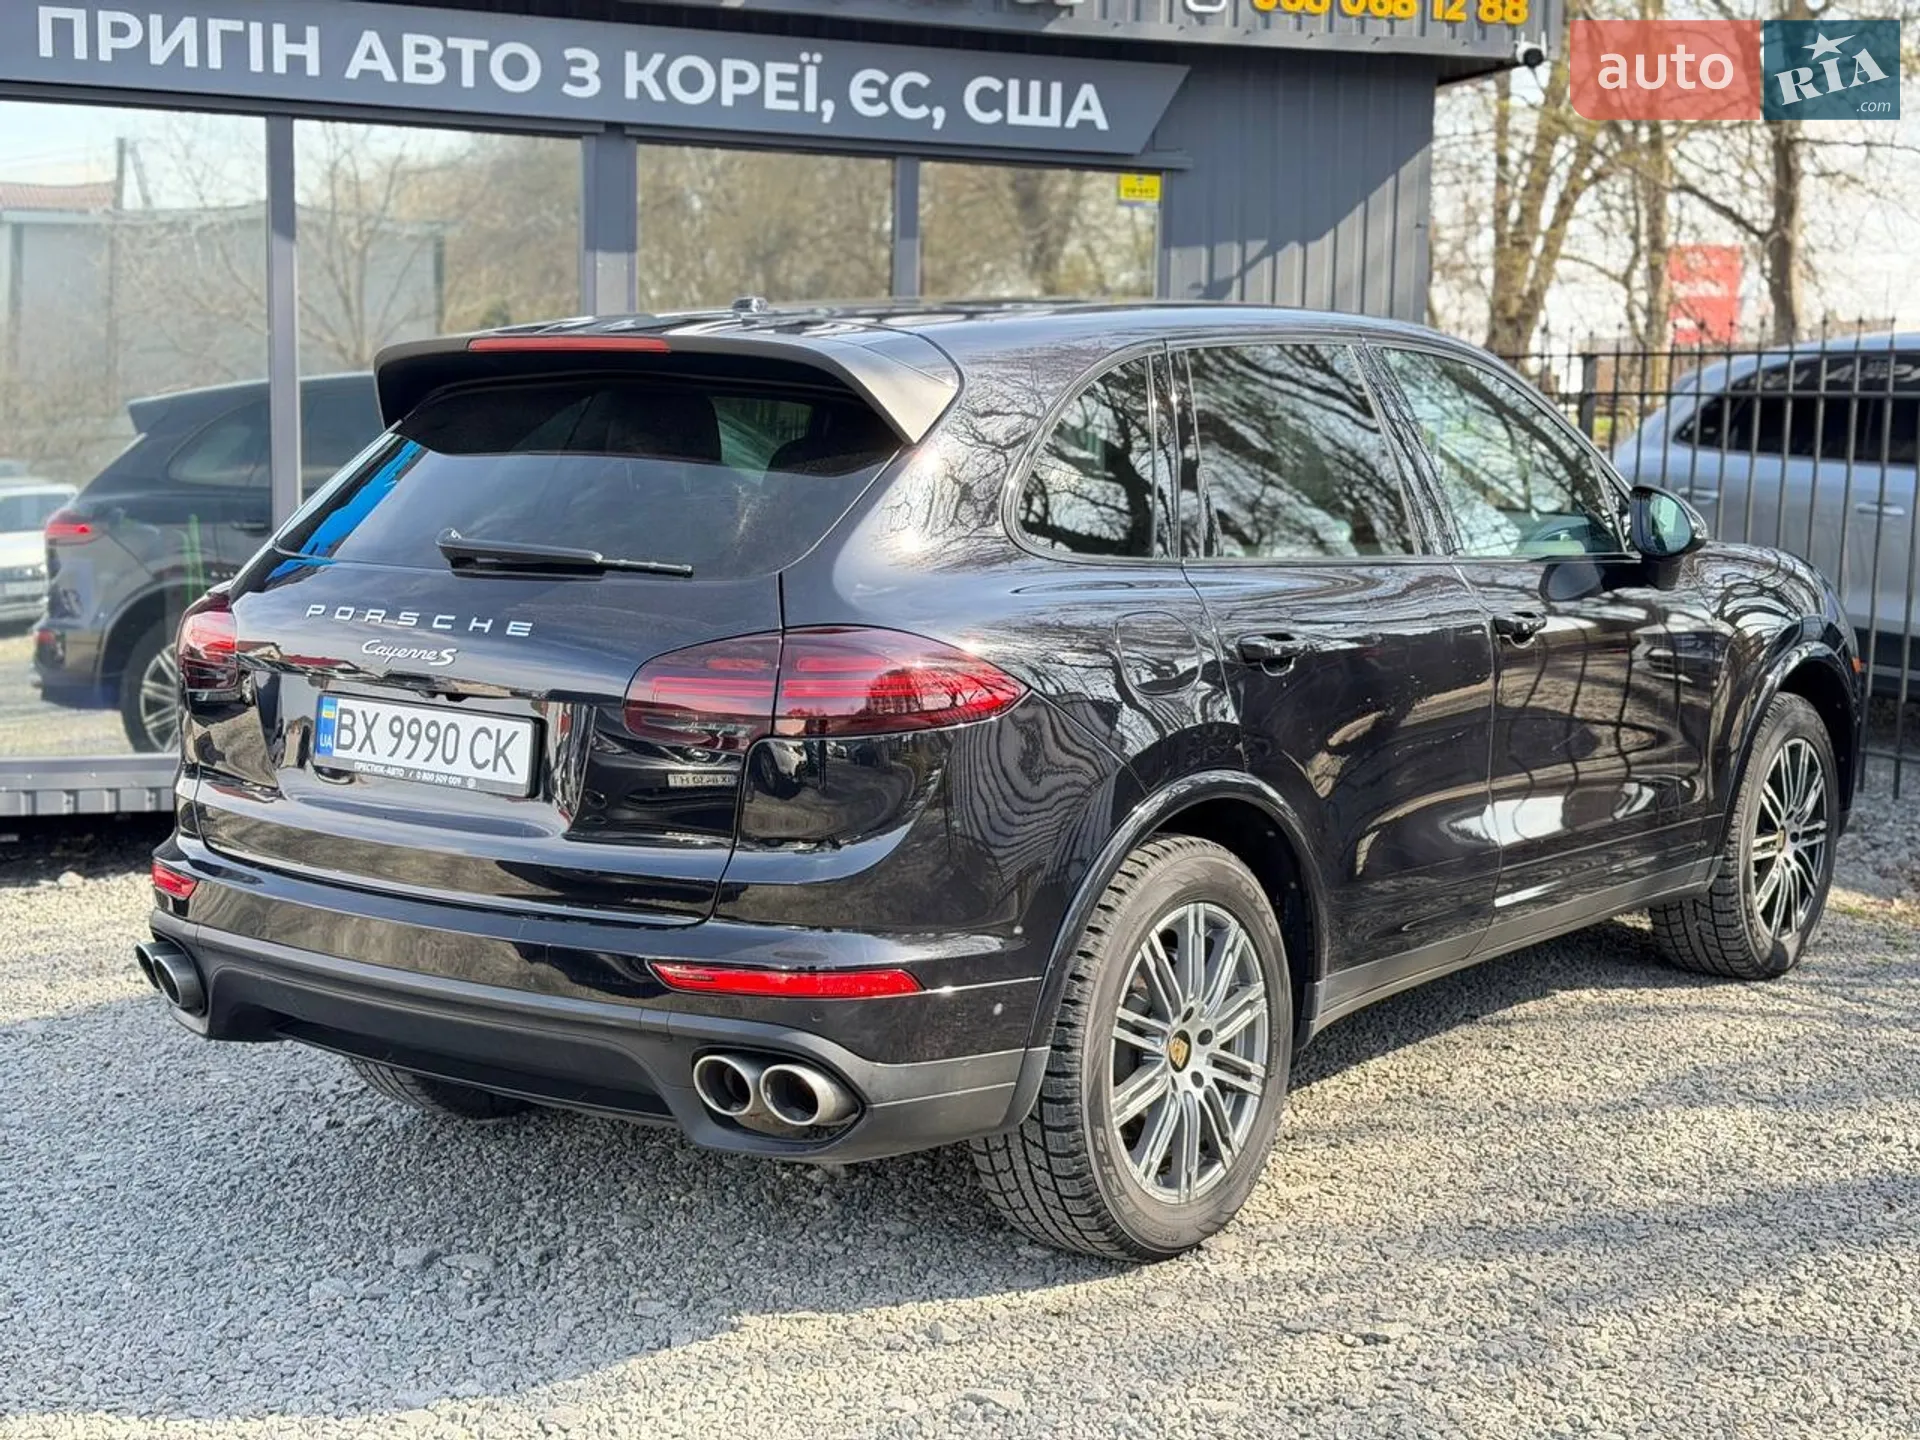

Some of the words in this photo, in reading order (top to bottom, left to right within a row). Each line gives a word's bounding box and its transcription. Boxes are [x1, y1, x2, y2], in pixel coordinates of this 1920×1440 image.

[1477, 0, 1529, 24] 88
[37, 5, 320, 77] ПРИГІН
[344, 30, 542, 93] АВТО
[624, 51, 835, 124] КОРЕЇ,
[849, 69, 946, 130] ЄС,
[964, 76, 1109, 130] США
[305, 603, 534, 637] PORSCHE
[361, 638, 437, 664] Cayenne
[429, 648, 458, 666] S
[320, 733, 334, 749] UA
[387, 714, 461, 766] 9990
